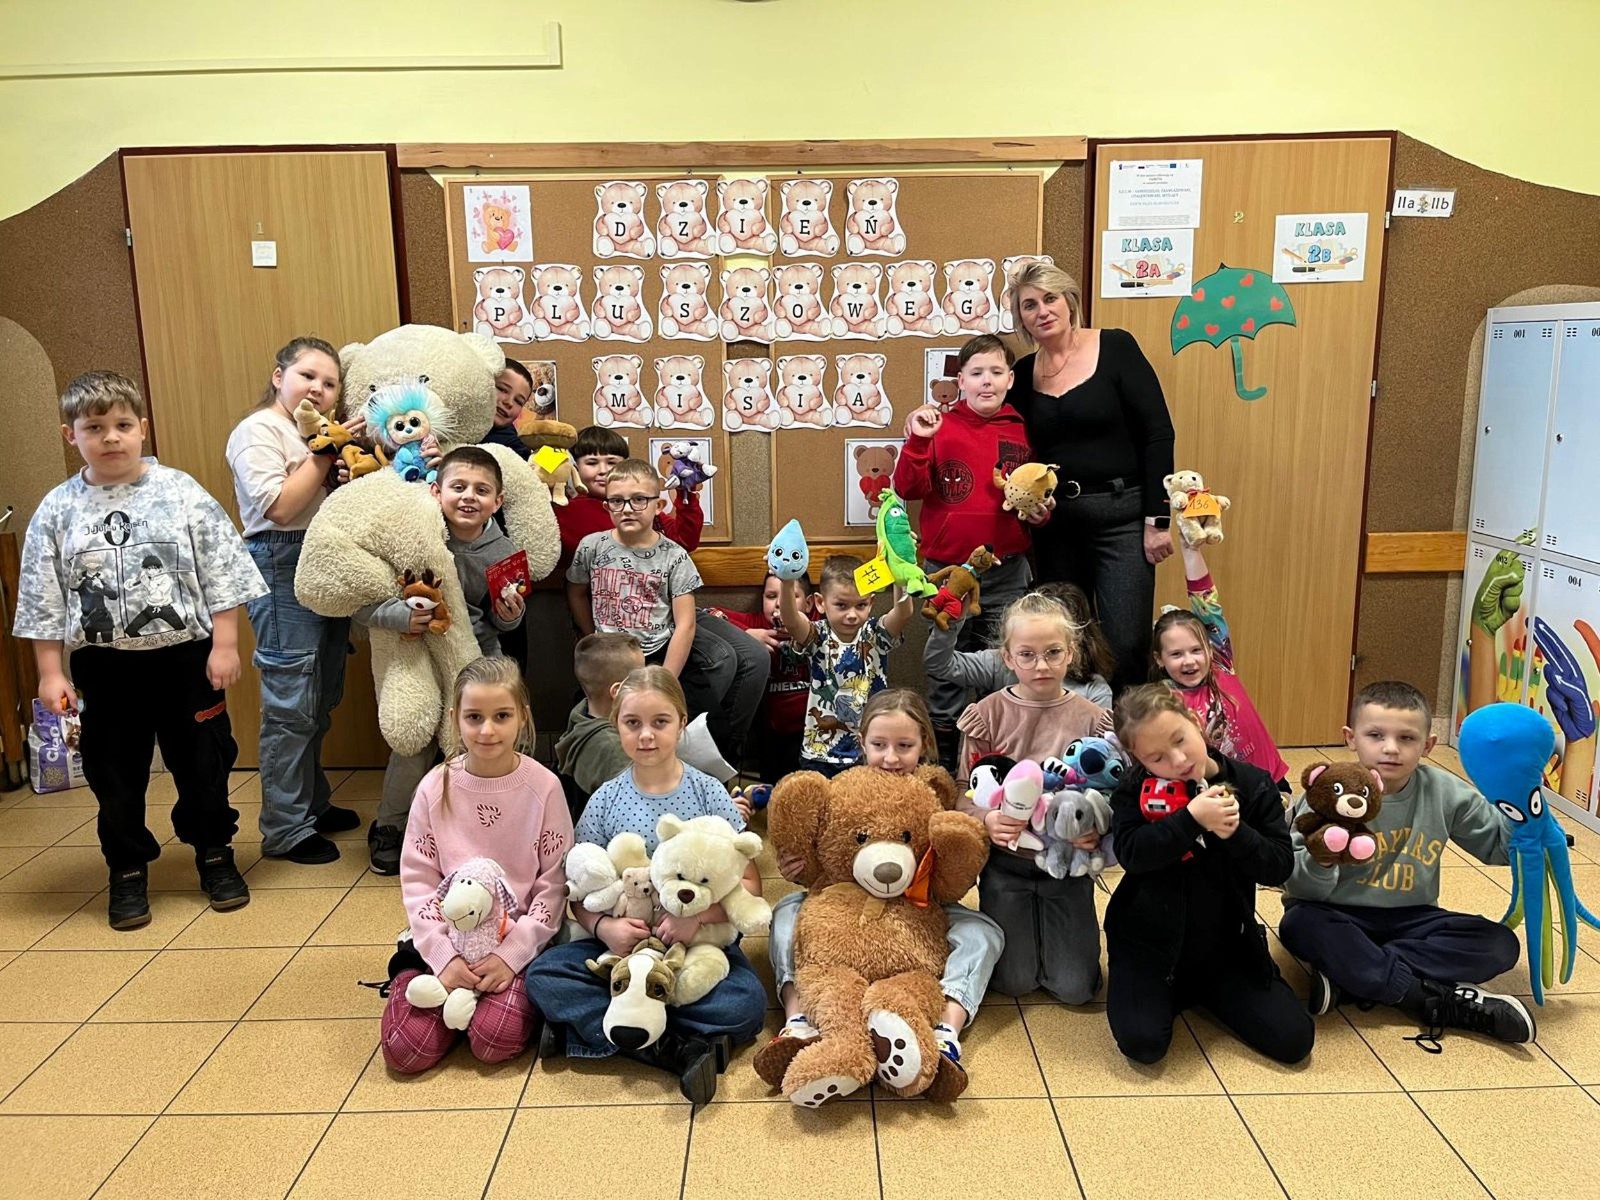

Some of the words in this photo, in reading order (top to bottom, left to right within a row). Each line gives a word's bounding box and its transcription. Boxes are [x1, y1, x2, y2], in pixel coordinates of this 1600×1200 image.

[1233, 211, 1245, 224] 2
[1294, 221, 1346, 238] KLASA
[1121, 237, 1173, 253] KLASA
[1308, 245, 1331, 264] 2B
[1136, 260, 1161, 279] 2A
[611, 392, 864, 411] MISIA
[1189, 499, 1209, 510] 136
[1356, 862, 1415, 892] LUB
